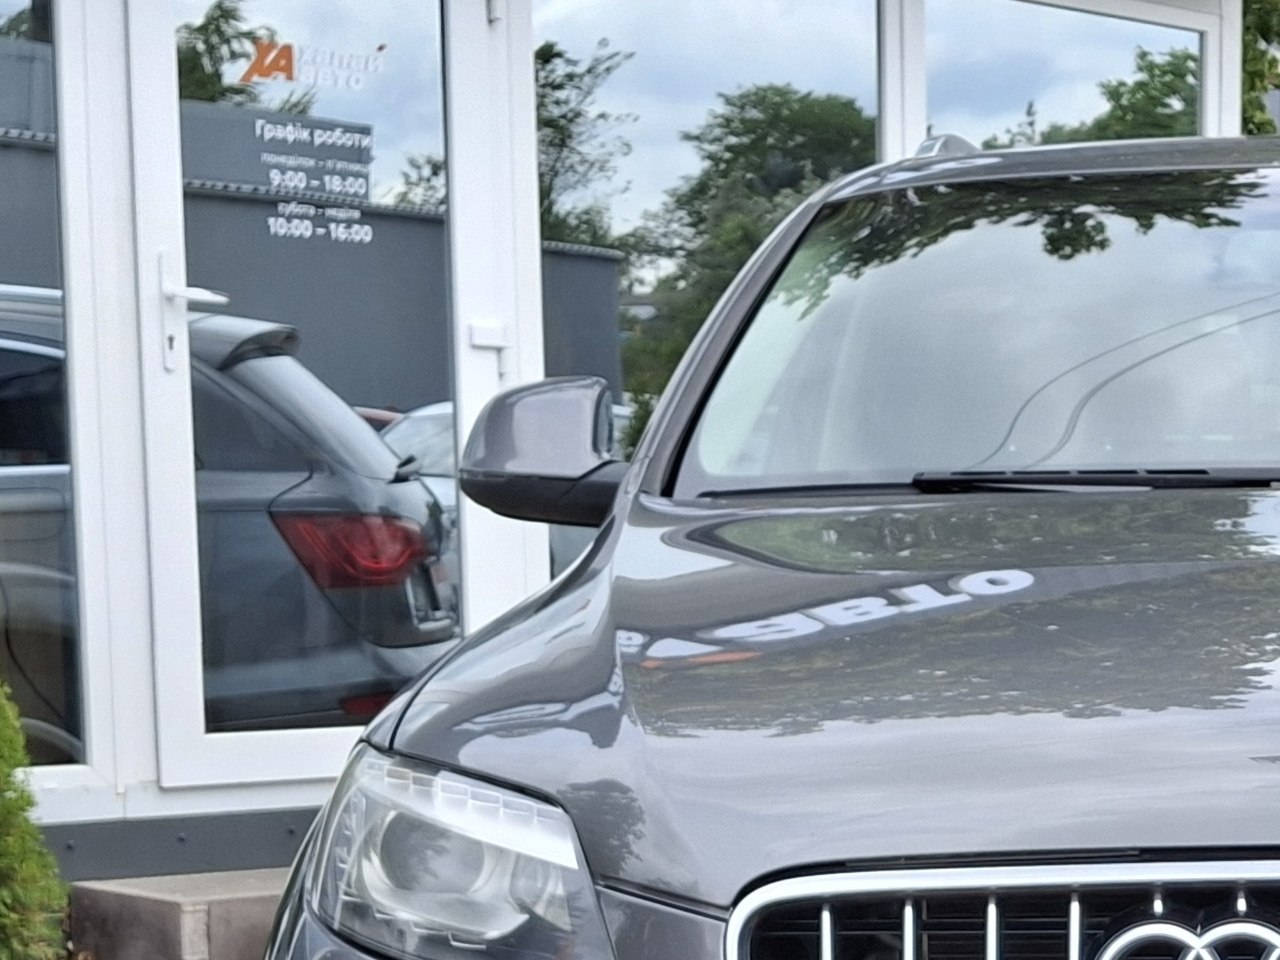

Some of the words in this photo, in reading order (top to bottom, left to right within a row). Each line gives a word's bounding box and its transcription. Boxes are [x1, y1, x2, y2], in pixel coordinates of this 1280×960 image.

[255, 118, 311, 145] Графік
[313, 128, 372, 148] роботи
[269, 168, 307, 190] 9:00
[323, 174, 367, 195] 18:00
[267, 216, 313, 238] 10:00
[328, 222, 373, 244] 16:00
